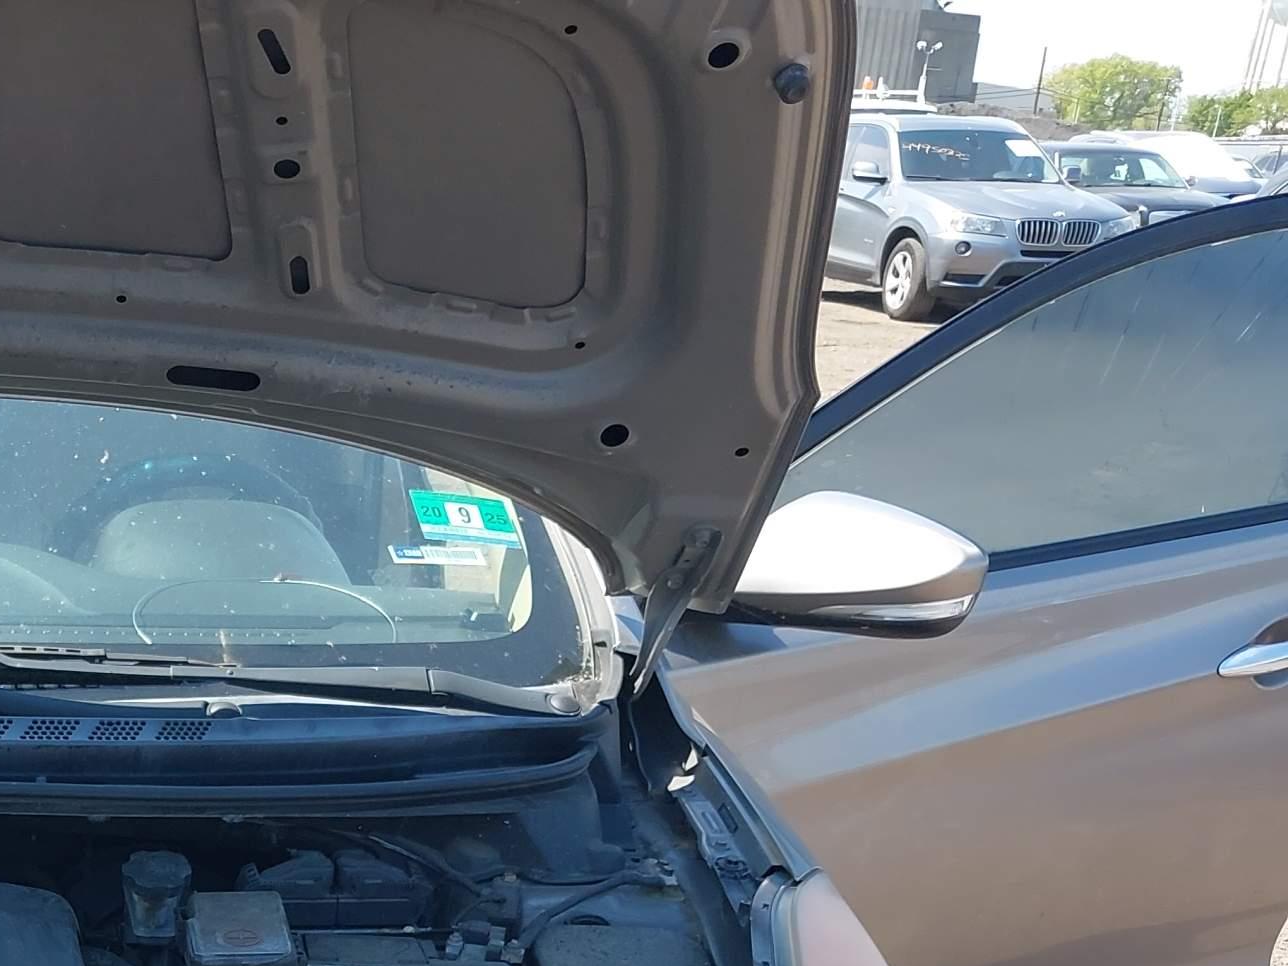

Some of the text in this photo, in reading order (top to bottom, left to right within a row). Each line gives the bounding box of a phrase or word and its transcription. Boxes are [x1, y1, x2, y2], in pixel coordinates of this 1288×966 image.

[420, 505, 507, 526] 20 9 25
